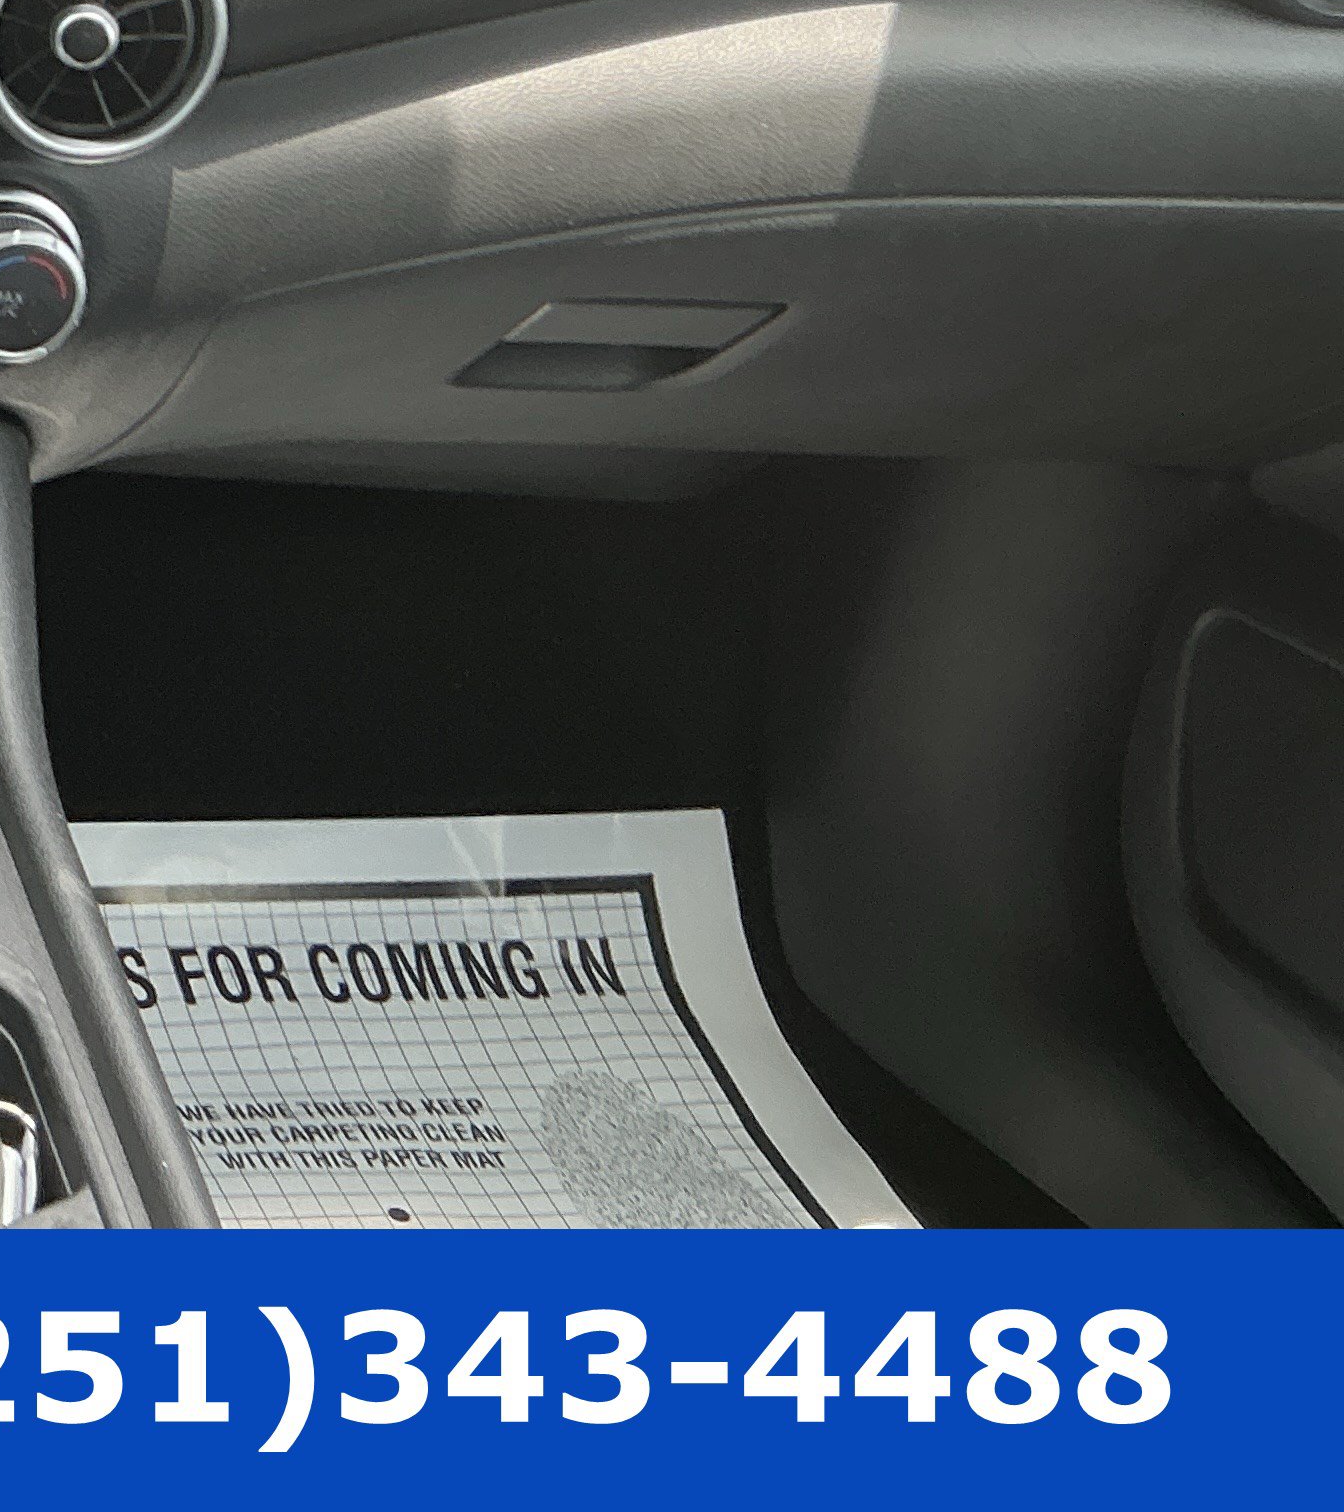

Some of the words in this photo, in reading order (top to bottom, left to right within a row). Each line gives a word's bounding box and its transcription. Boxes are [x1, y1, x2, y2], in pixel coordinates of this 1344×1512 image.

[169, 944, 300, 1006] FOR
[308, 939, 550, 1005] COMING
[557, 937, 628, 999] IN
[176, 1103, 223, 1124] WE
[223, 1101, 292, 1122] HAVE
[297, 1099, 376, 1120] TRIED
[378, 1098, 418, 1119] TO
[420, 1096, 484, 1118] KEEP
[187, 1126, 266, 1148] YOUR
[270, 1123, 417, 1145] CARPETING
[422, 1121, 508, 1144] CLEAN
[216, 1151, 293, 1171] WITH
[297, 1150, 359, 1170] THIS
[361, 1149, 449, 1170] PAPER
[449, 1149, 509, 1170] MAT
